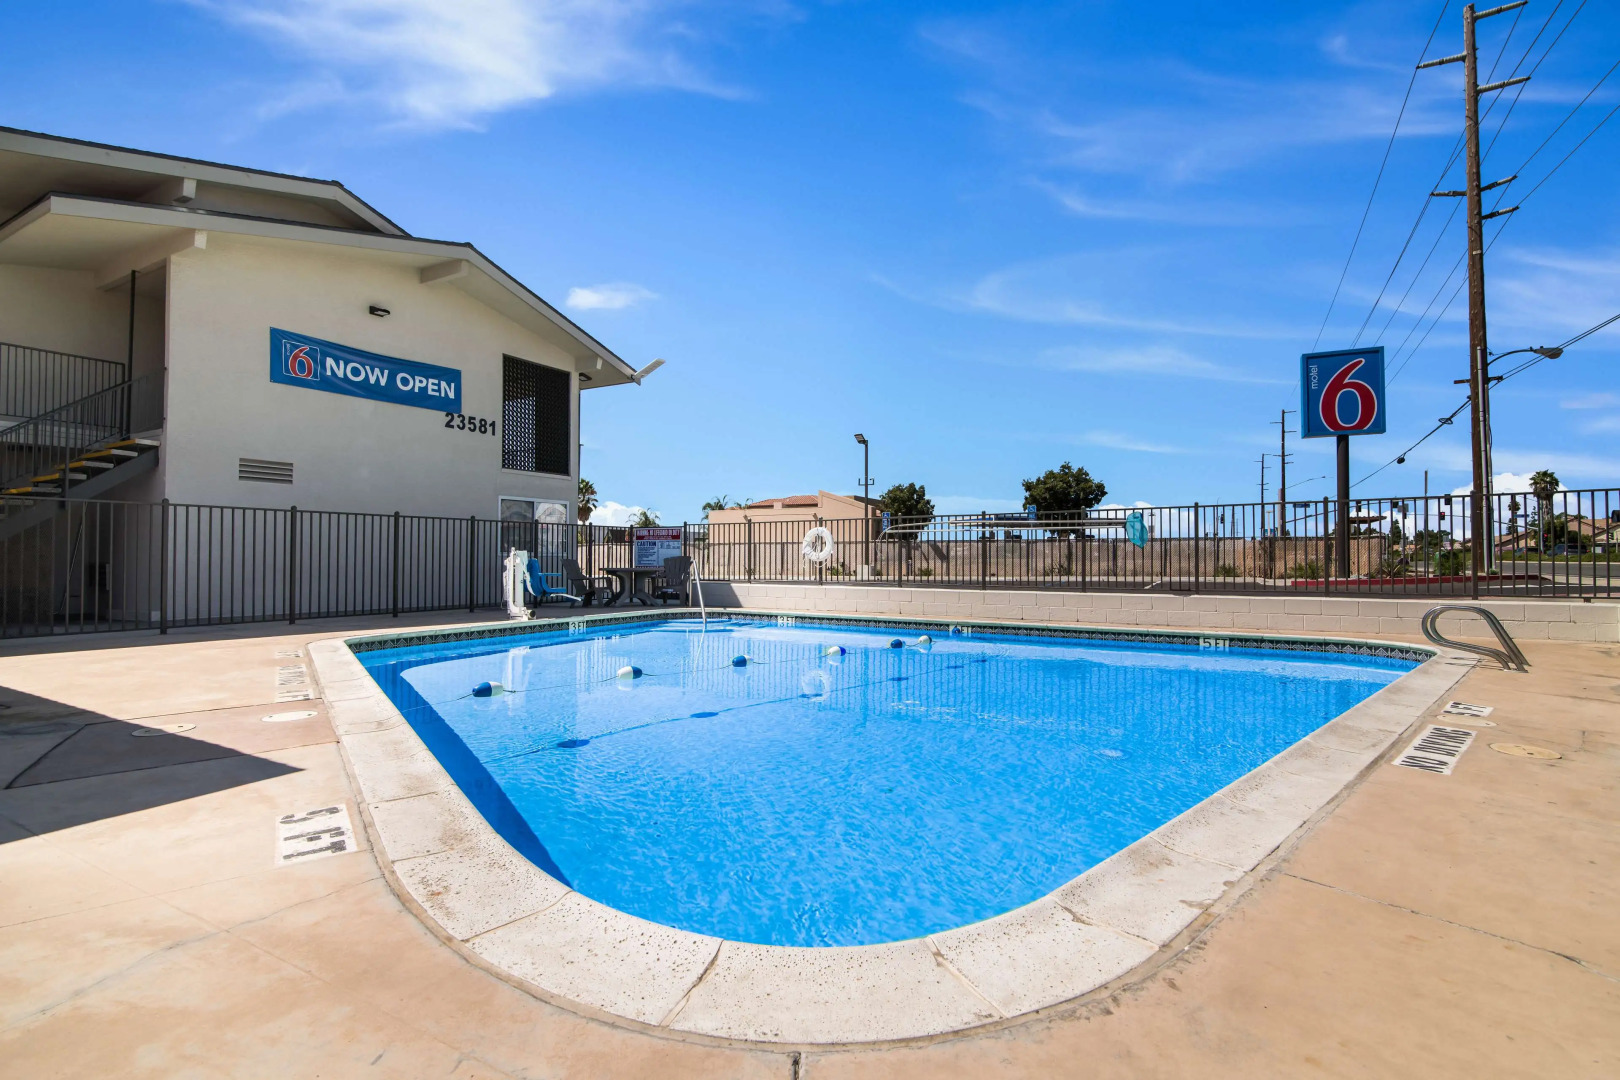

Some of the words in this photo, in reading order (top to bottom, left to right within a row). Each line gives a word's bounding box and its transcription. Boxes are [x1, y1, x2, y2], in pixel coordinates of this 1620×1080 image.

[289, 346, 314, 378] 6
[325, 357, 388, 386] NOW
[396, 373, 455, 399] OPEN
[1309, 365, 1318, 389] motel
[1319, 358, 1377, 431] 6
[445, 412, 496, 436] 23581
[1203, 637, 1212, 649] 5
[1215, 637, 1227, 650] FT
[1413, 727, 1473, 758] DIVING
[1399, 755, 1449, 773] NO
